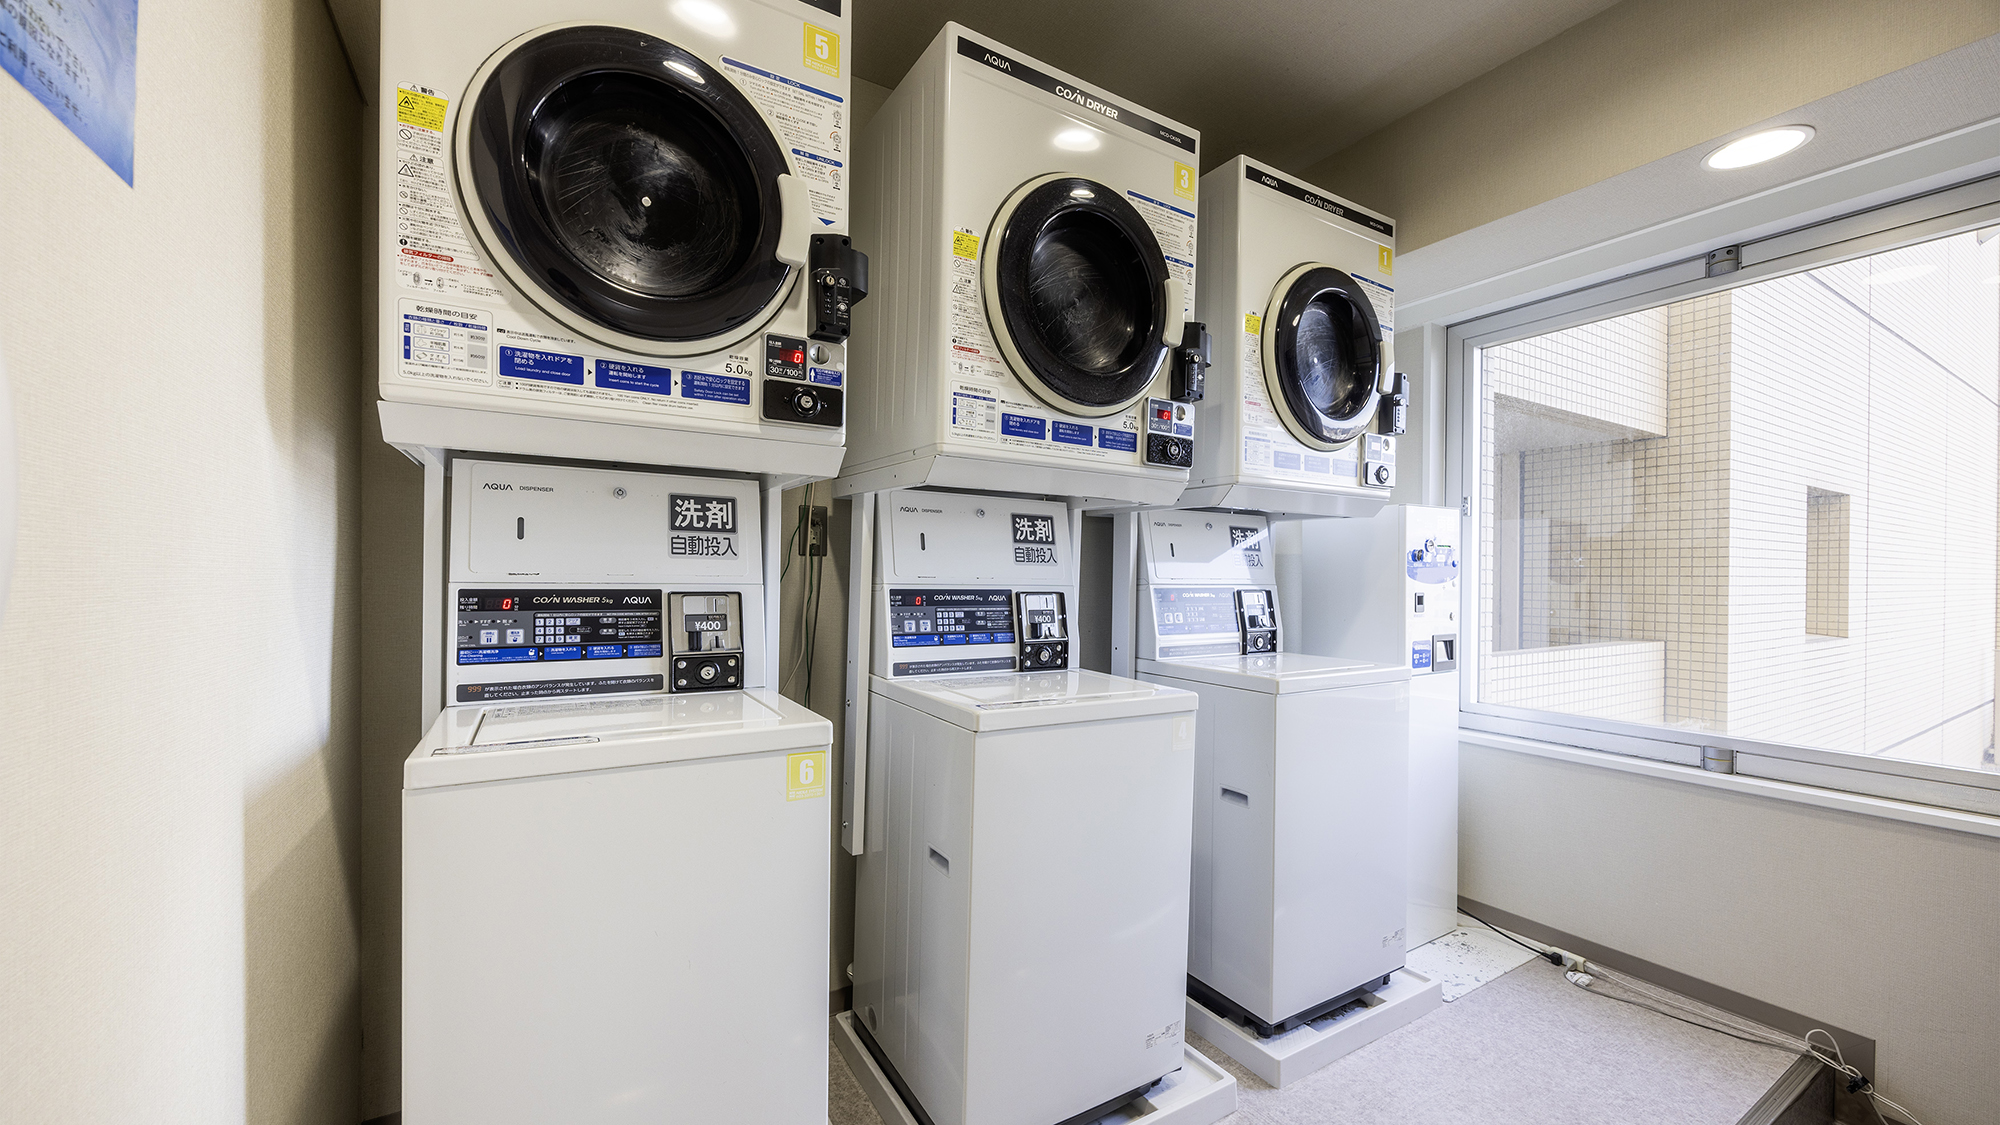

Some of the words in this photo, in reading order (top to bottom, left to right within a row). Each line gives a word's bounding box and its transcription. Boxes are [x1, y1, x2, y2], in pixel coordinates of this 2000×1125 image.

[816, 34, 828, 59] 5
[984, 53, 1012, 72] AQUA
[1086, 98, 1119, 120] DRYER
[1181, 169, 1189, 188] 3
[1261, 175, 1279, 188] AQUA
[1323, 203, 1344, 217] DRYER
[1383, 251, 1387, 265] 1
[415, 305, 478, 321] 乾燥時間の目安
[514, 350, 573, 365] 洗濯物を入れドアを
[514, 357, 534, 366] 閉める
[794, 353, 801, 363] 0
[609, 363, 644, 373] 硬貨を入れる
[609, 370, 646, 379] 運転を開始します
[483, 483, 513, 491] AQUA
[674, 498, 733, 530] 洗剤
[1014, 517, 1053, 542] 洗剤
[670, 535, 738, 557] 自動投入
[1232, 529, 1259, 550] 洗剤
[1014, 547, 1057, 564] 自動投入
[502, 598, 512, 610] 0
[915, 597, 922, 605] 0
[695, 621, 721, 631] ¥400
[1034, 615, 1051, 623] ¥400
[467, 685, 482, 693] 999
[1178, 721, 1187, 740] 4
[800, 759, 814, 785] 6
